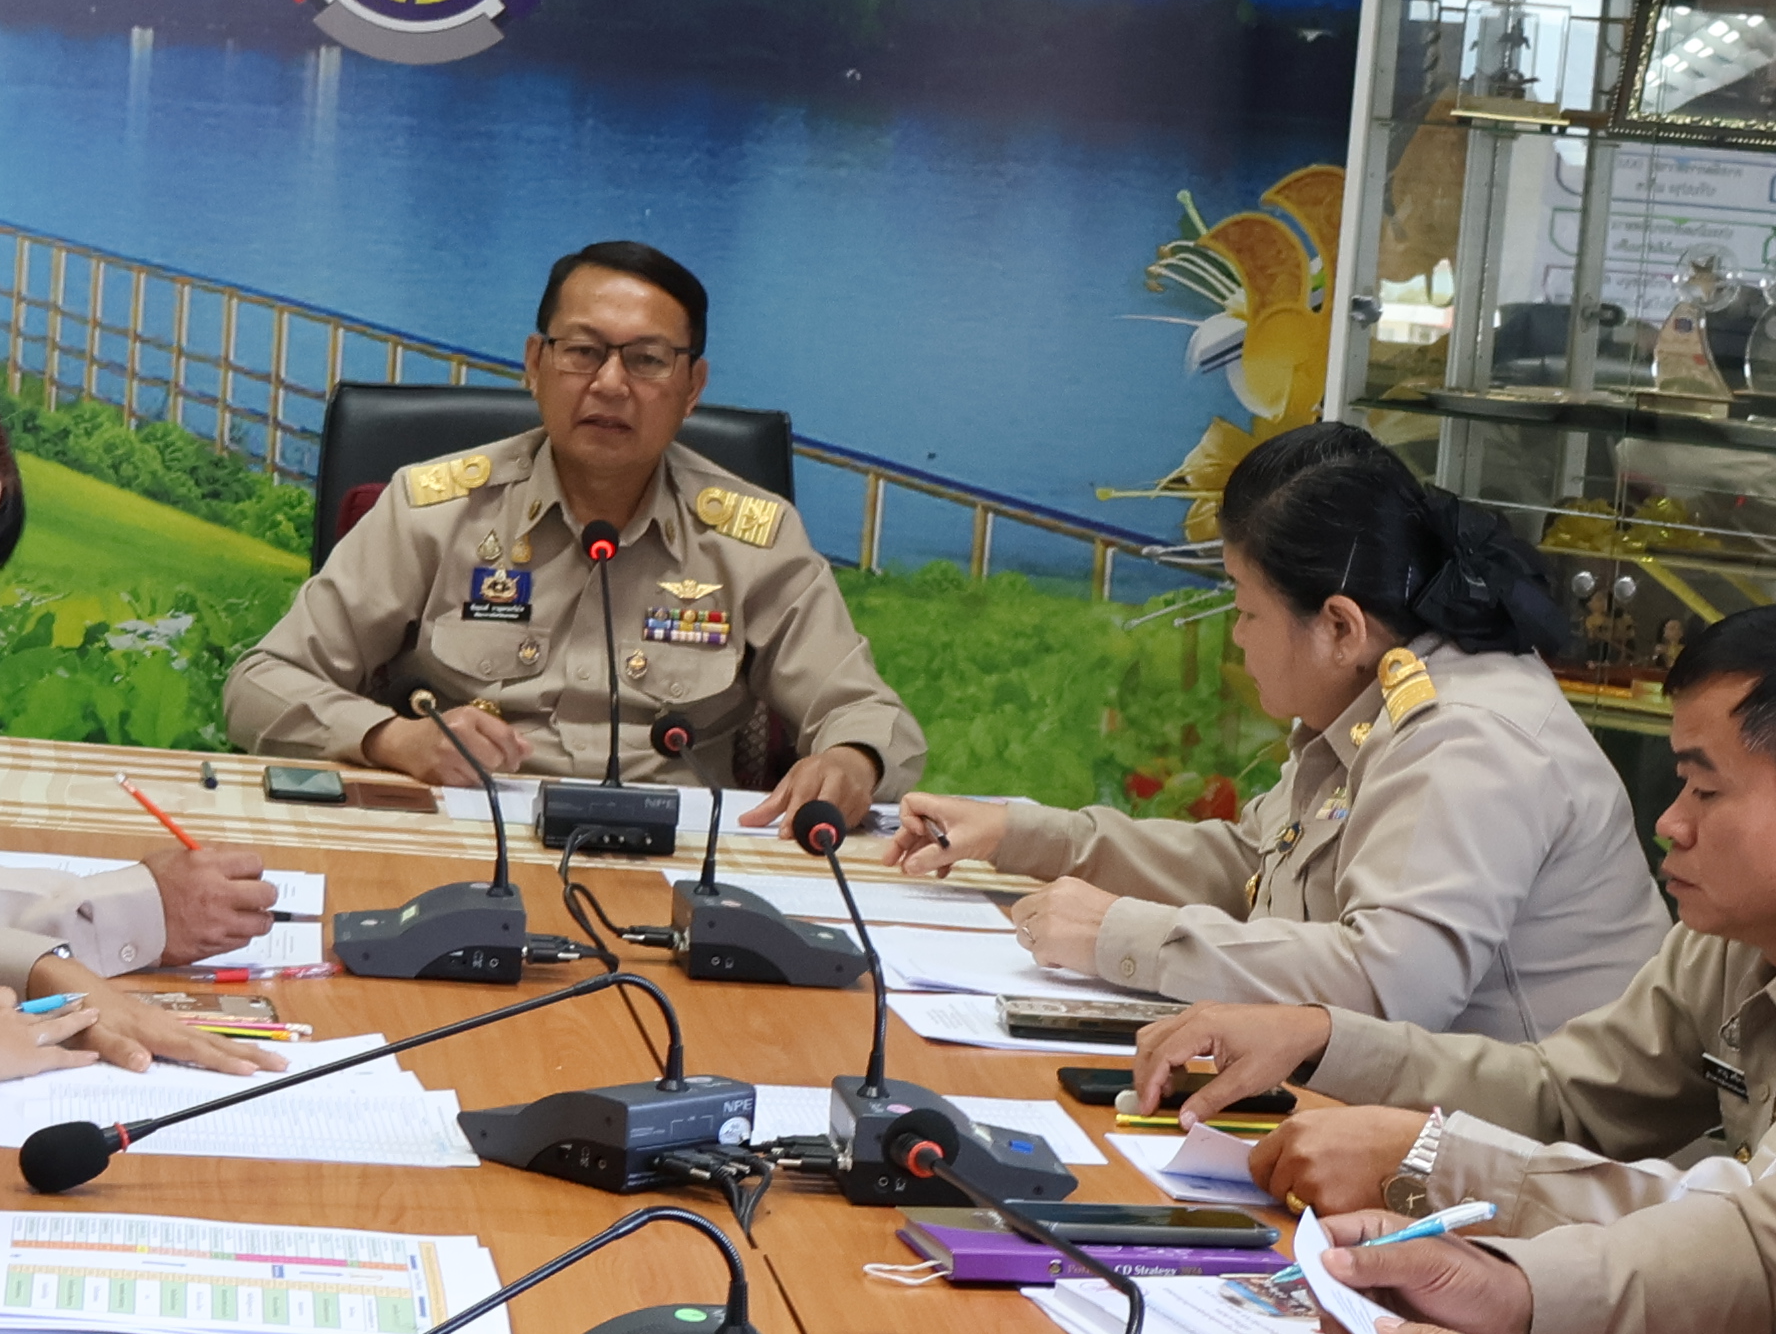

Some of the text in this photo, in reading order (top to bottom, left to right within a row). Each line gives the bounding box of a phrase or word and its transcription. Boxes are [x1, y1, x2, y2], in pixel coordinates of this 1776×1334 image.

[723, 1097, 753, 1114] NPE
[1114, 1264, 1133, 1276] CD
[1134, 1264, 1177, 1277] Strategy
